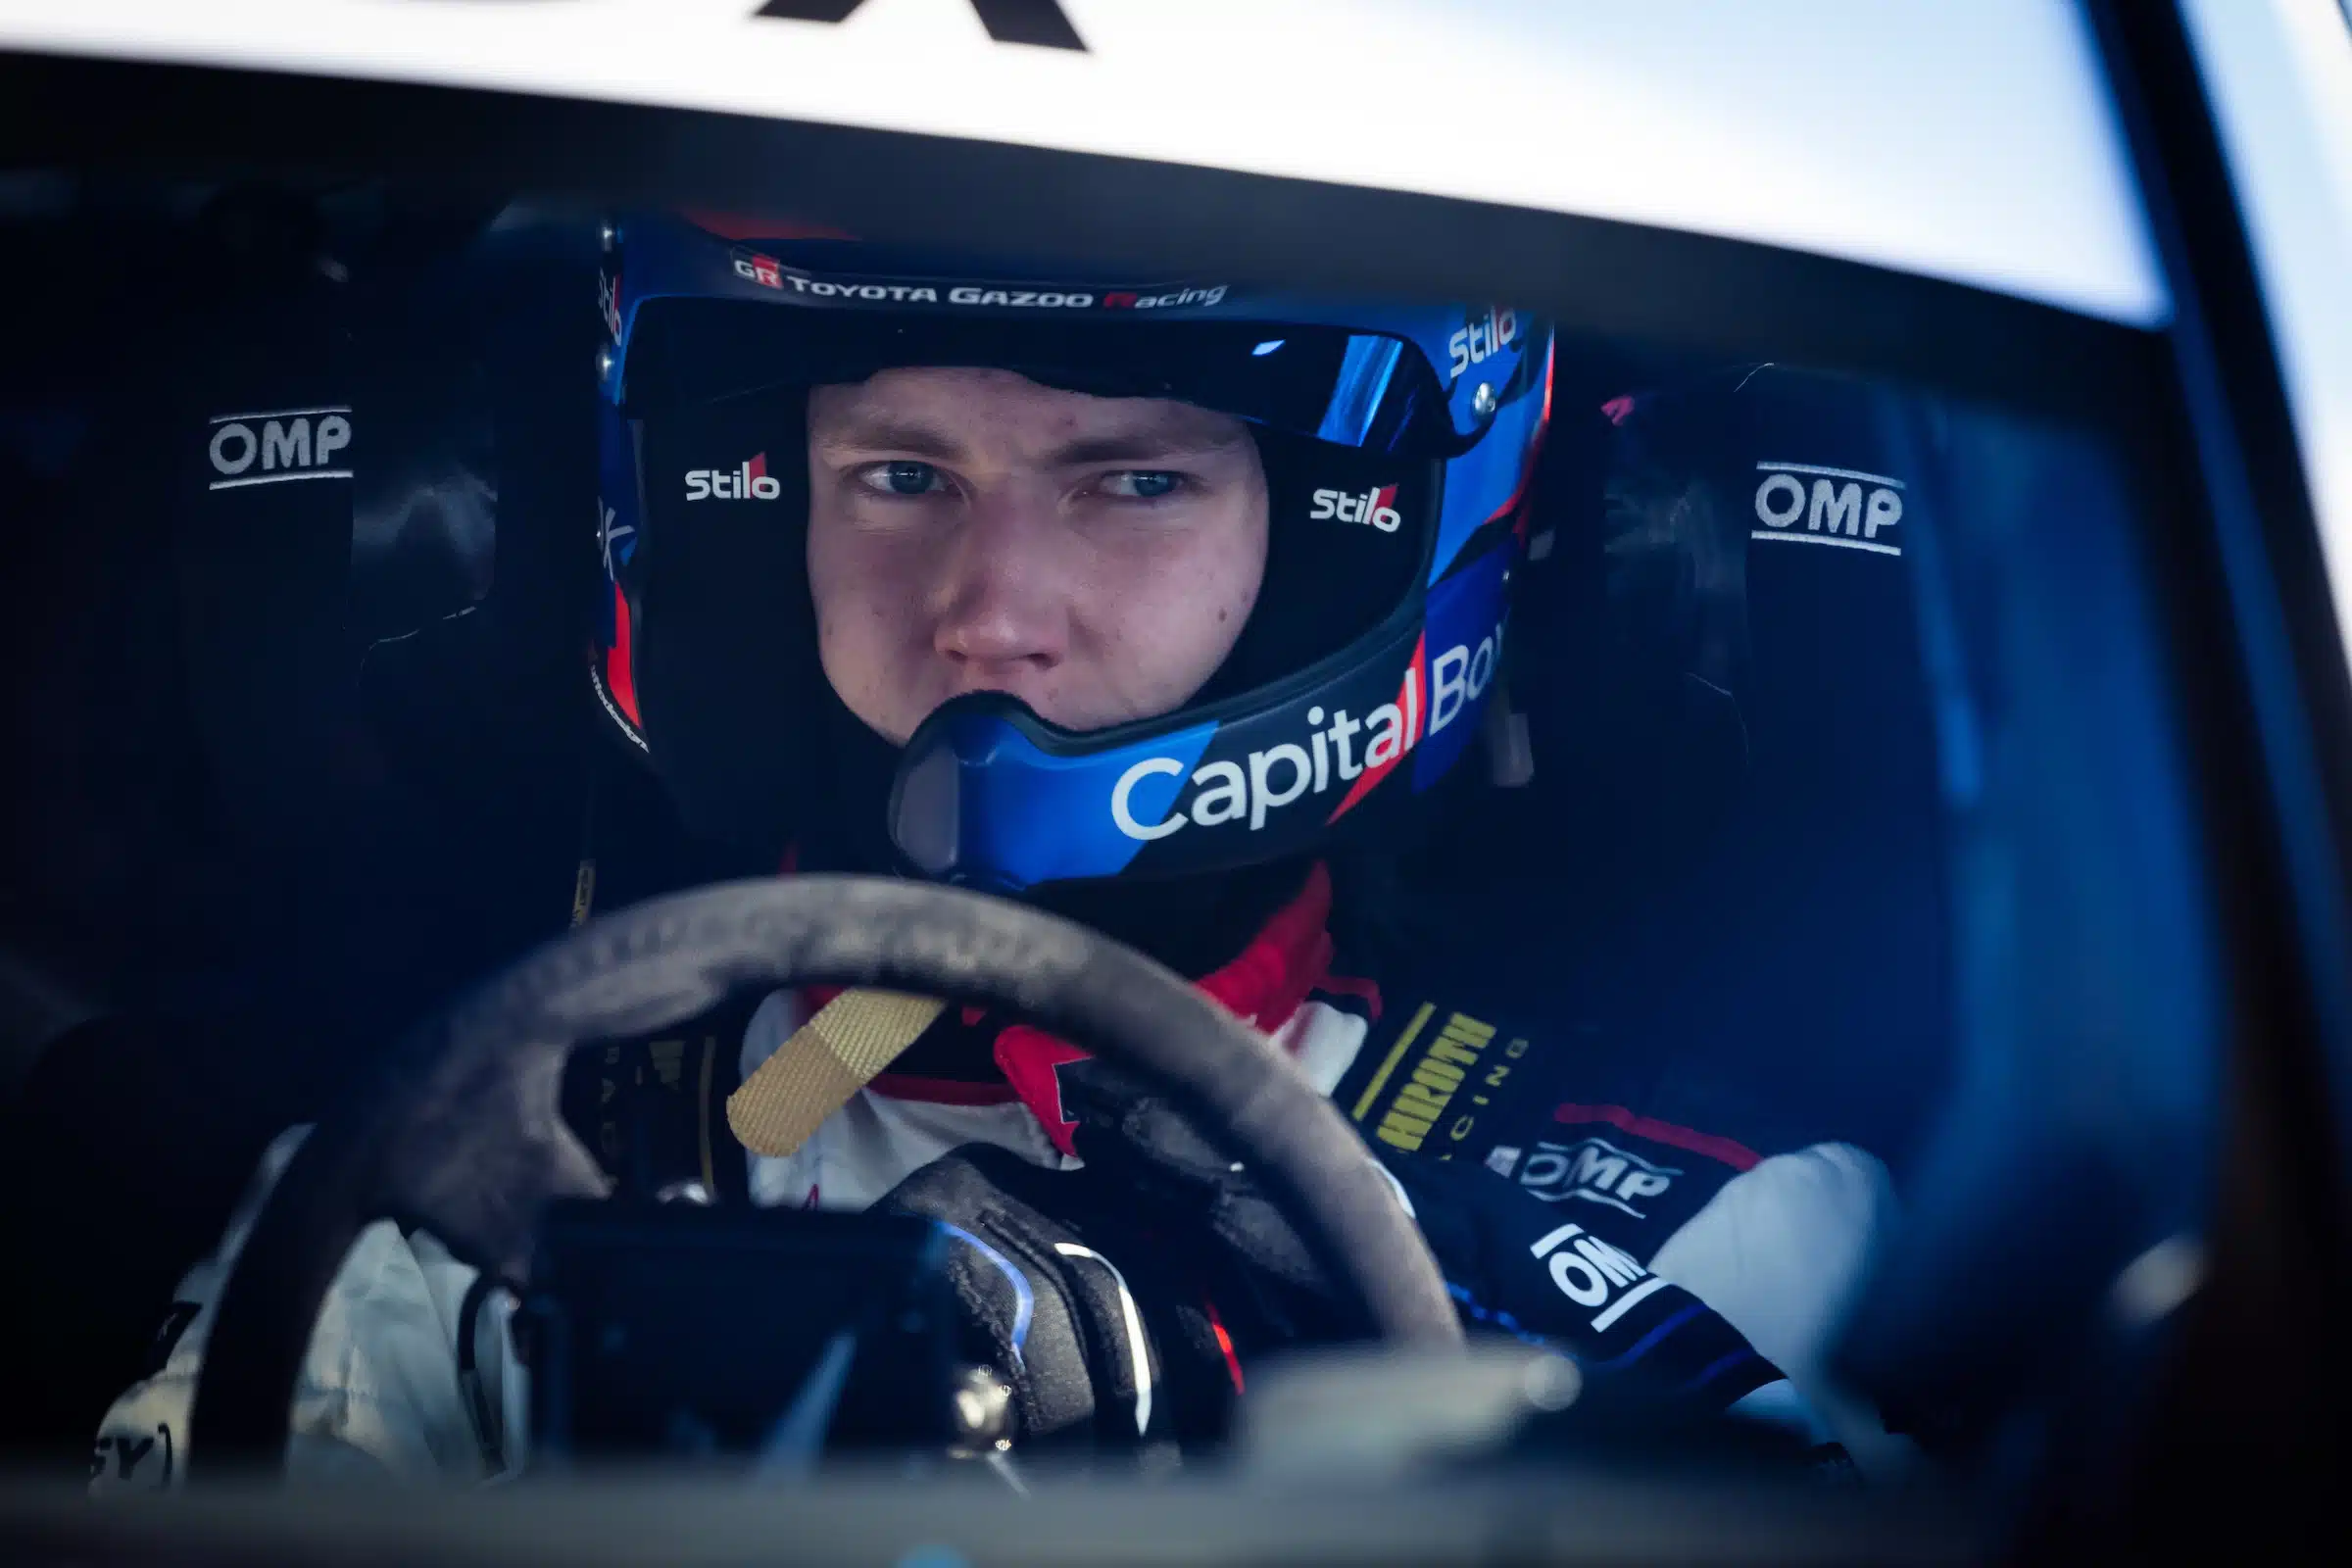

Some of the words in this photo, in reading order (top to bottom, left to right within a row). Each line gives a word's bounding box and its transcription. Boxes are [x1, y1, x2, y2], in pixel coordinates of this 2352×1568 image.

[733, 258, 782, 288] GR
[787, 275, 937, 303] TOYOTA
[949, 287, 1094, 309] GAZOO
[1103, 284, 1231, 310] Racing
[1448, 306, 1517, 379] Stilo
[209, 415, 352, 475] OMP
[684, 461, 781, 502] Stilo
[1310, 486, 1401, 533] Stilo
[1754, 473, 1903, 539] OMP
[1520, 1145, 1671, 1200] OMP
[1547, 1235, 1648, 1307] OM
